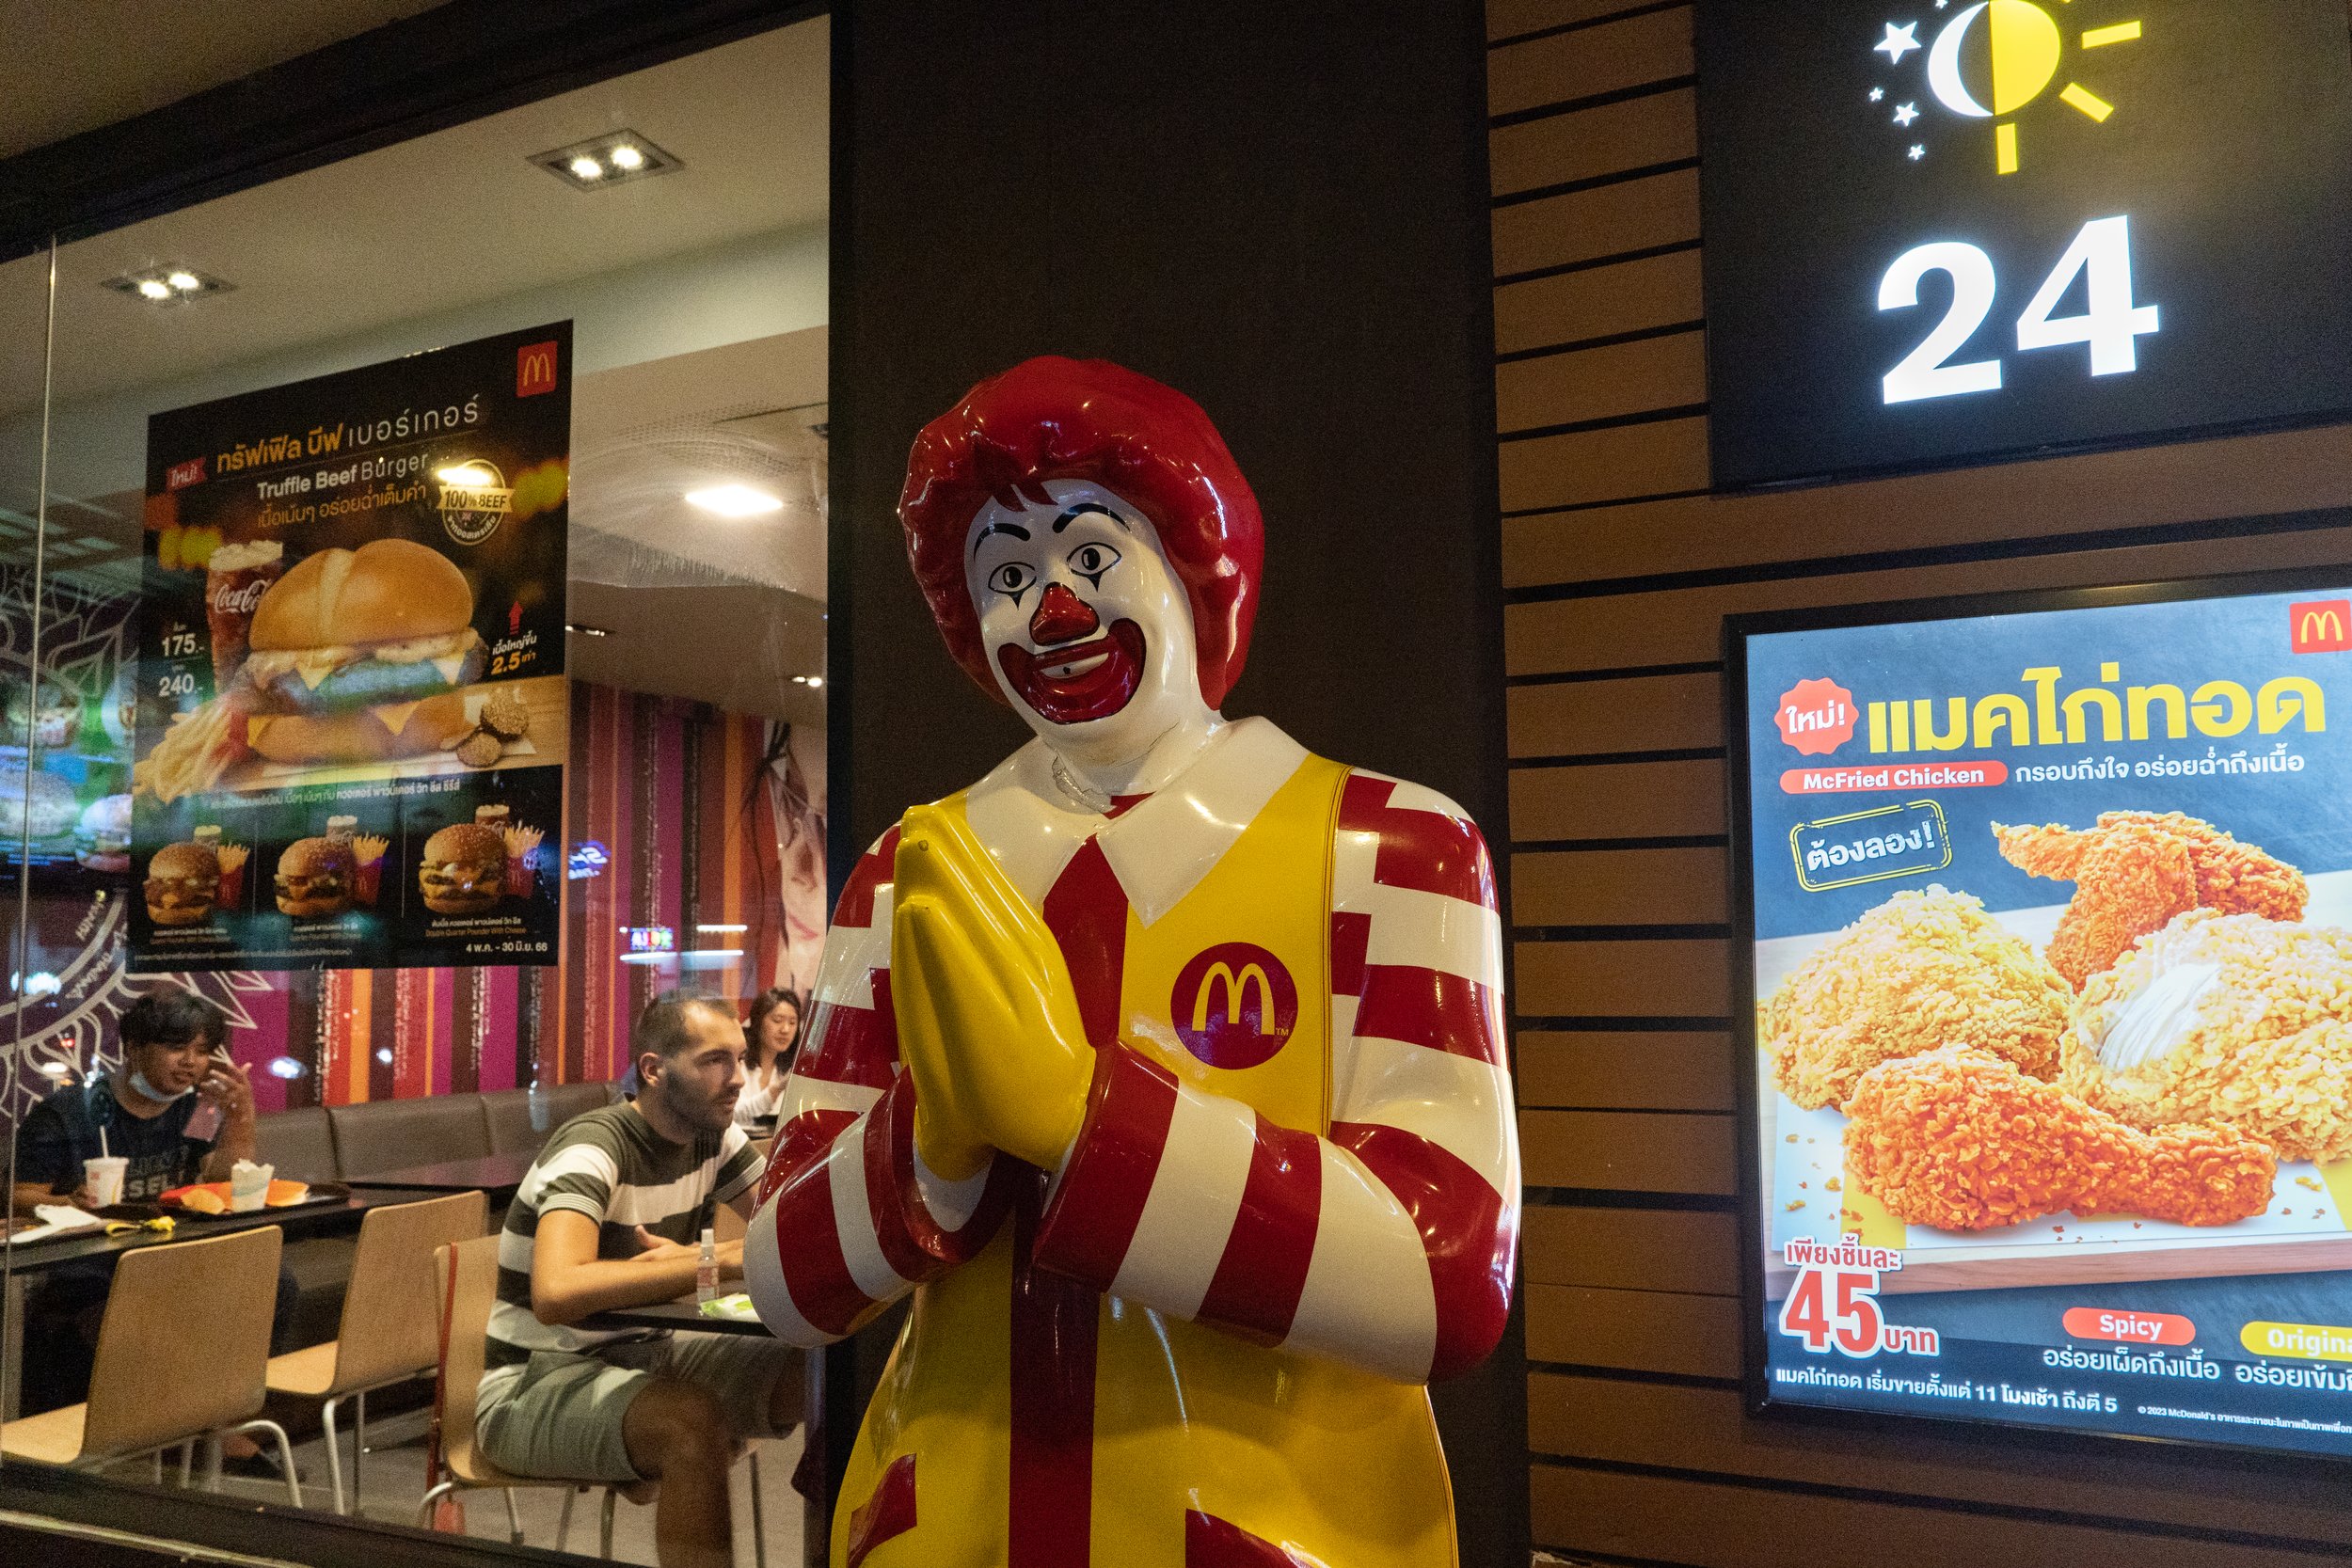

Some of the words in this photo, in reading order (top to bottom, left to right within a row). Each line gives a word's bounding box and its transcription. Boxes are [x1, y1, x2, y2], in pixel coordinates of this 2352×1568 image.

[1878, 214, 2159, 404] 24
[308, 422, 344, 455] บีฟ
[349, 393, 480, 448] เบอร์เกอร์
[257, 475, 311, 499] Truffle
[316, 464, 358, 489] Beef
[361, 453, 429, 480] Burger
[479, 494, 508, 509] BEEF
[491, 651, 521, 675] 2.5
[1785, 700, 1846, 734] ใหม่!
[1867, 661, 2327, 753] แมคไก่ทอด
[1804, 769, 1889, 790] McFried
[1893, 767, 1984, 787] Chicken
[2015, 755, 2130, 783] กรอบถึงใจ
[2134, 742, 2305, 778] อร่อยฉ่ำถึงเนื้อ
[1806, 820, 1935, 871] ต้องลอง!
[466, 943, 472, 953] 4
[501, 942, 514, 952] 30
[1788, 1236, 1899, 1269] เพียงชิ้นละ
[1785, 1270, 1879, 1353] 45
[1884, 1327, 1936, 1353] บาท
[2099, 1314, 2163, 1341] Spicy
[2042, 1345, 2221, 1380] อร่อยเผ็ดถึงเนื้อ
[1776, 1367, 1863, 1389] แมคไก่ทอด
[1866, 1369, 1972, 1400] เริ่มขายตั้งแต่
[1976, 1385, 1996, 1402] 11
[2000, 1383, 2058, 1408] โมงเช้า
[2062, 1389, 2101, 1412] ถึงตี
[2105, 1397, 2119, 1413] 5
[2147, 1406, 2167, 1417] 2023
[2168, 1408, 2216, 1421] McDonald's
